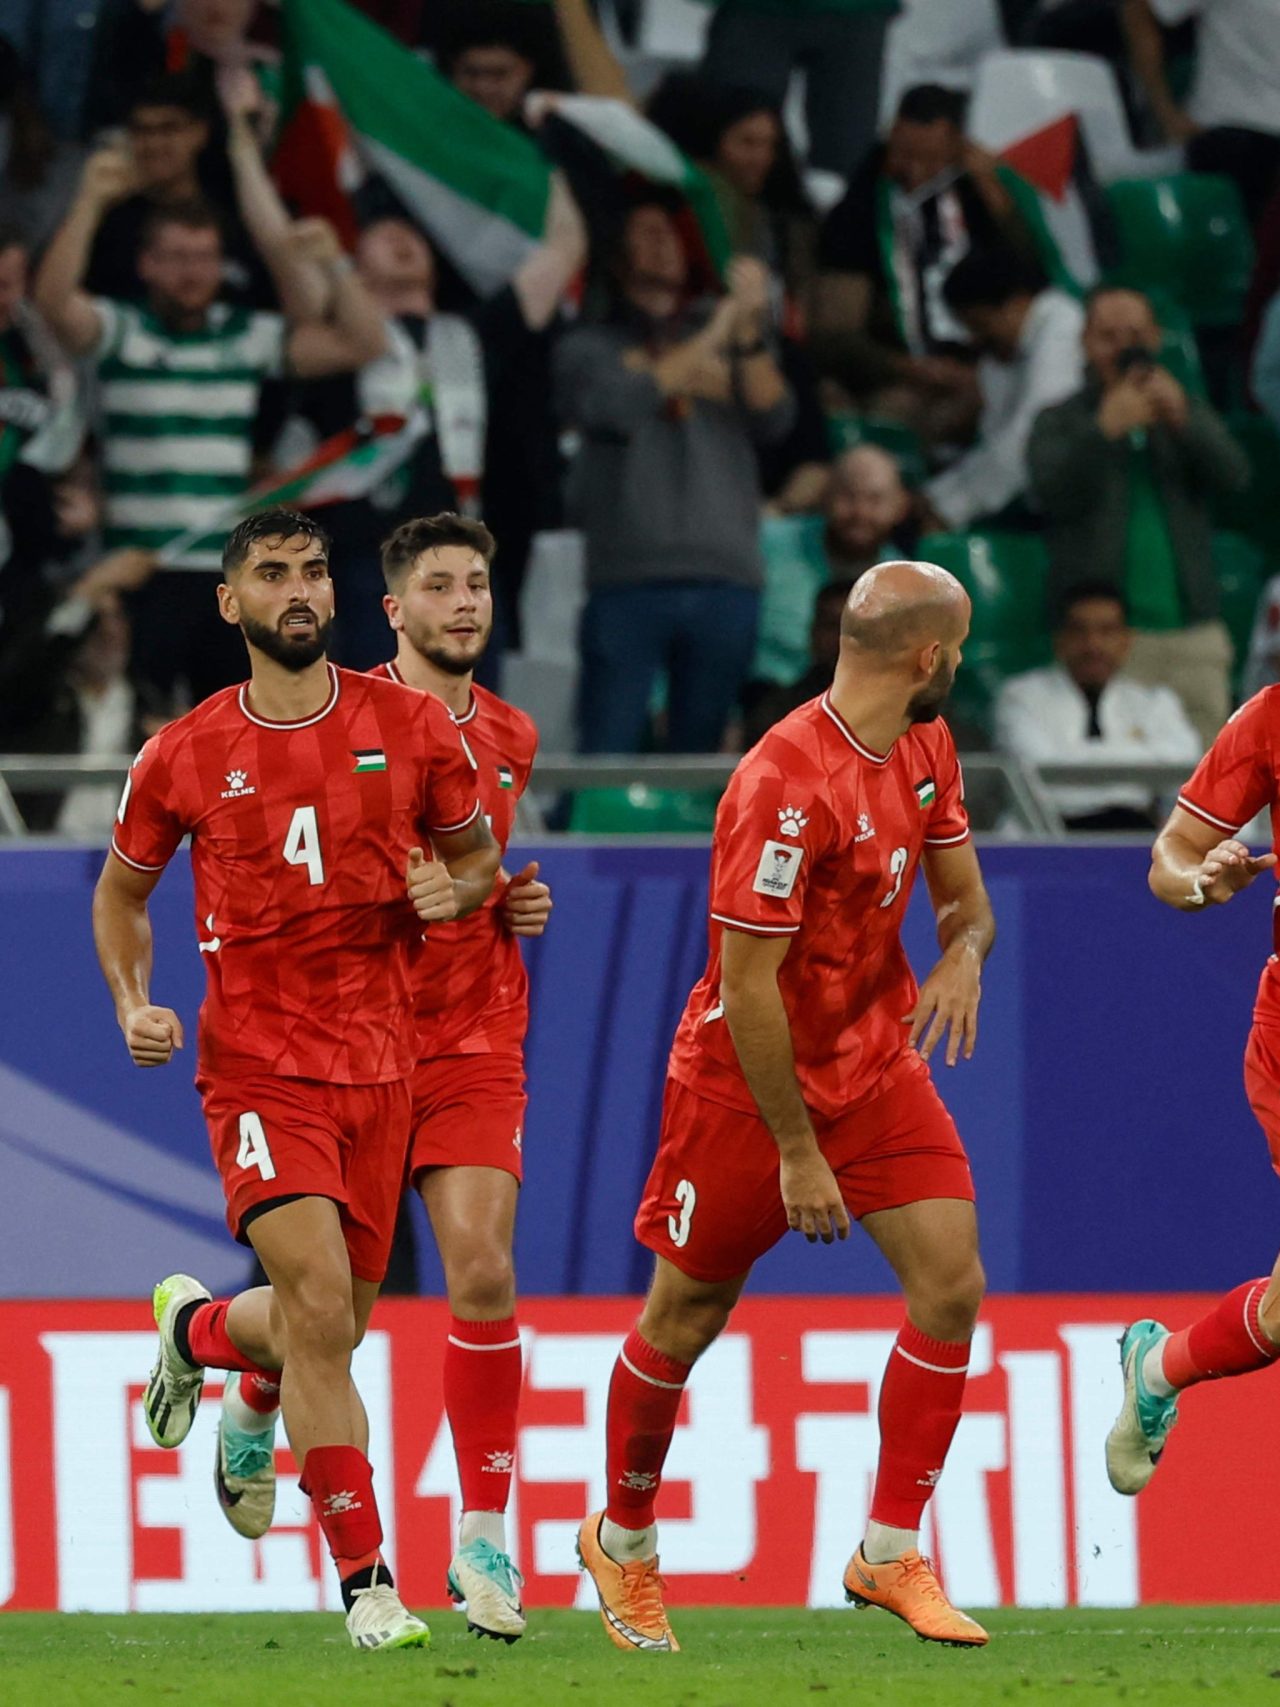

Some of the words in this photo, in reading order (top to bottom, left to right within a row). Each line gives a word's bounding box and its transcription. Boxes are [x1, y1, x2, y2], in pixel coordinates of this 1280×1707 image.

[220, 786, 256, 799] KELME
[282, 805, 324, 885] 4
[235, 1111, 276, 1181] 4
[667, 1179, 696, 1248] 3
[0, 1323, 1139, 1611] 国伊利
